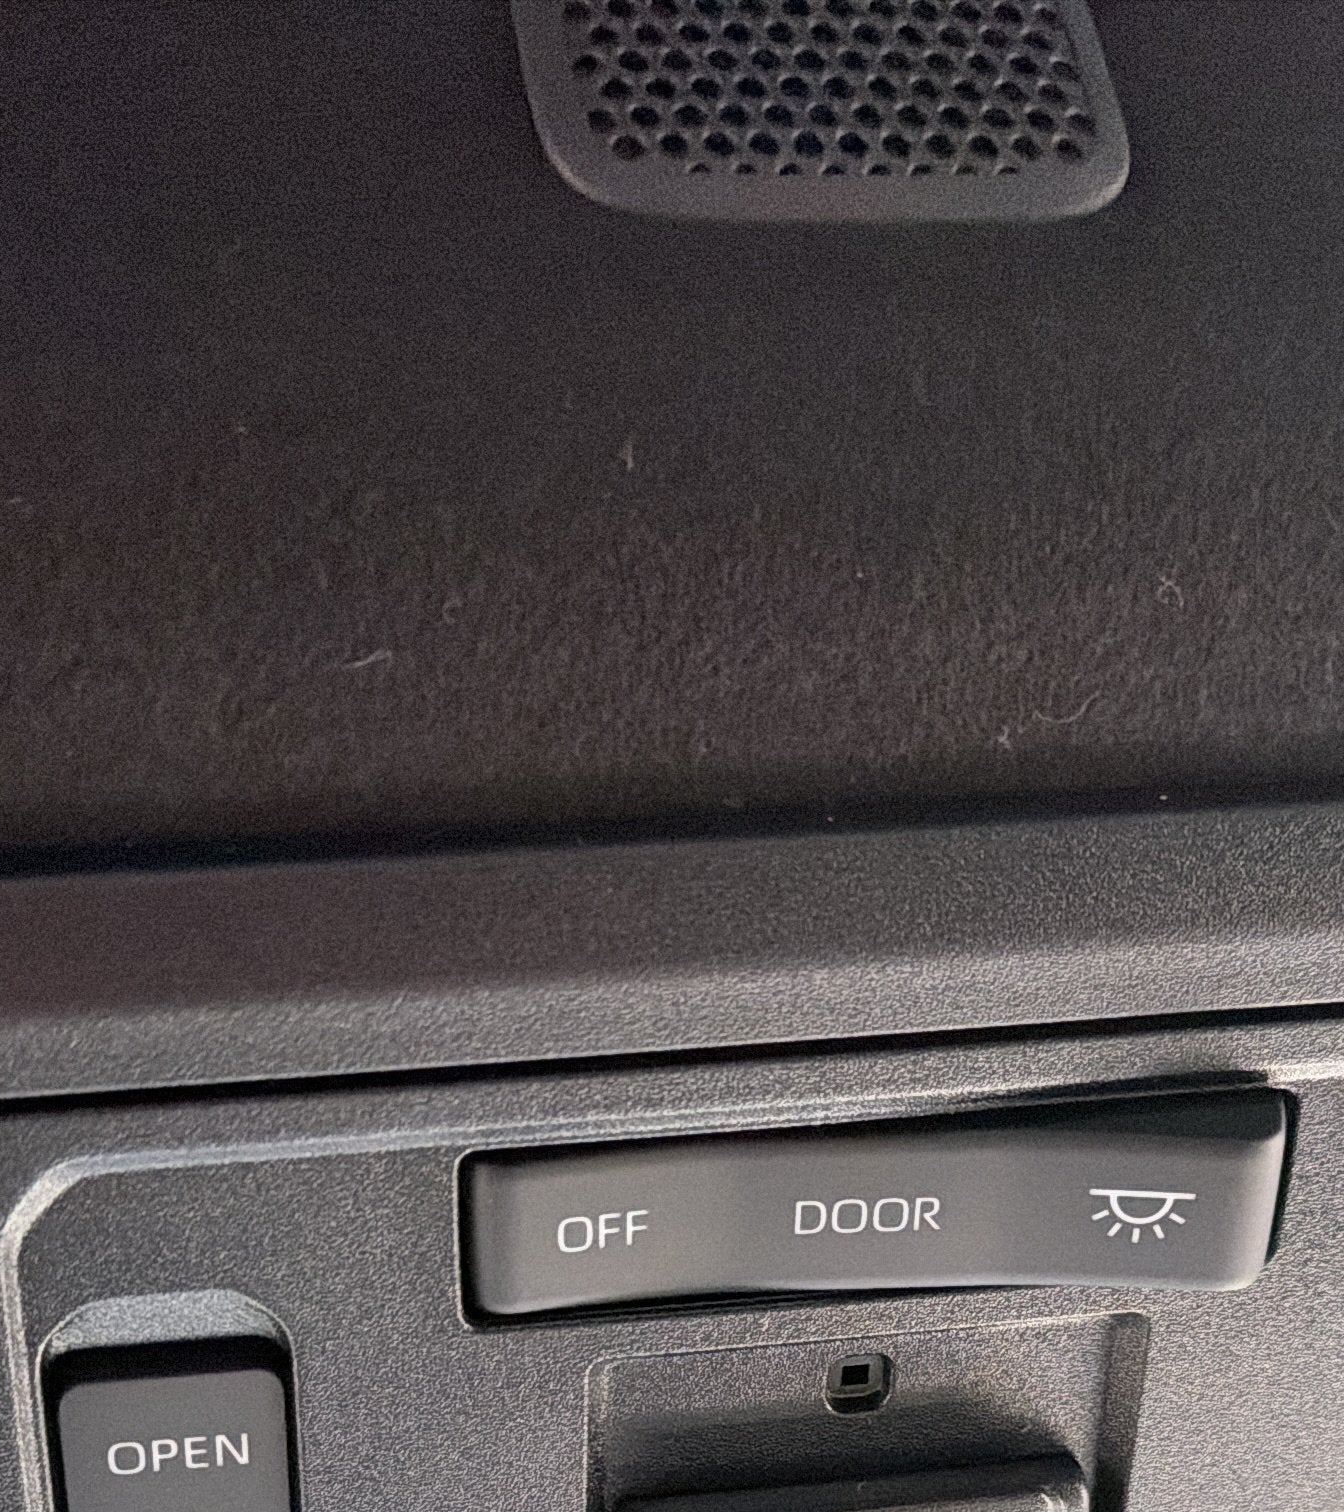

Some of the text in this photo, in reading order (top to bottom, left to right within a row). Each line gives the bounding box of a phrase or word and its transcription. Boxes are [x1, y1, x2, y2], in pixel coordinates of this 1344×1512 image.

[557, 1208, 649, 1254] OFF
[794, 1197, 941, 1235] DOOR
[107, 1433, 250, 1475] OPEN
